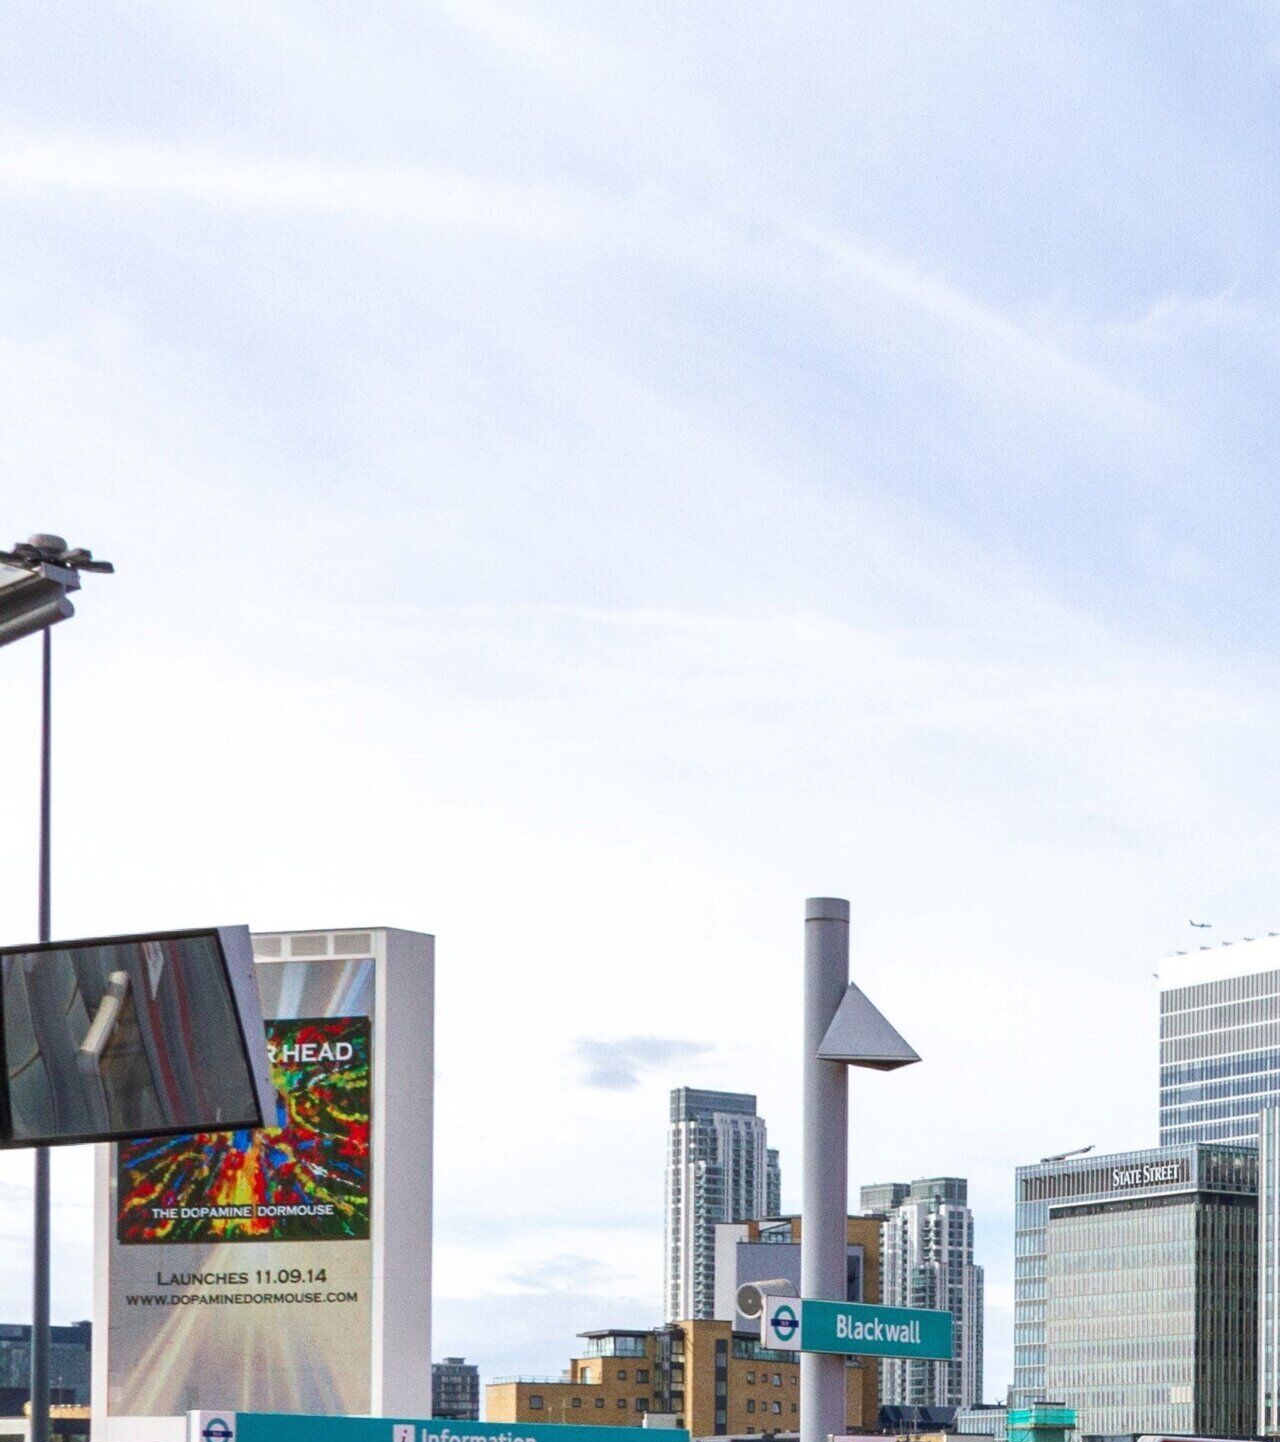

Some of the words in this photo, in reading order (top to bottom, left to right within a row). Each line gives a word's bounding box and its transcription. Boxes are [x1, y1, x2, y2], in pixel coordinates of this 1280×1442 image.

[282, 1041, 353, 1063] HEAD
[1112, 1168, 1142, 1187] STATE
[1143, 1164, 1180, 1183] STREET
[151, 1208, 178, 1219] THE
[181, 1206, 252, 1219] DOPAMINE
[257, 1204, 334, 1217] DORMOUSE
[157, 1271, 249, 1286] LAUNCHES
[256, 1269, 327, 1284] 11.09.14
[126, 1291, 358, 1306] WWW.DOPAMINEDORMOUSE.COM
[835, 1314, 922, 1344] Blackwall
